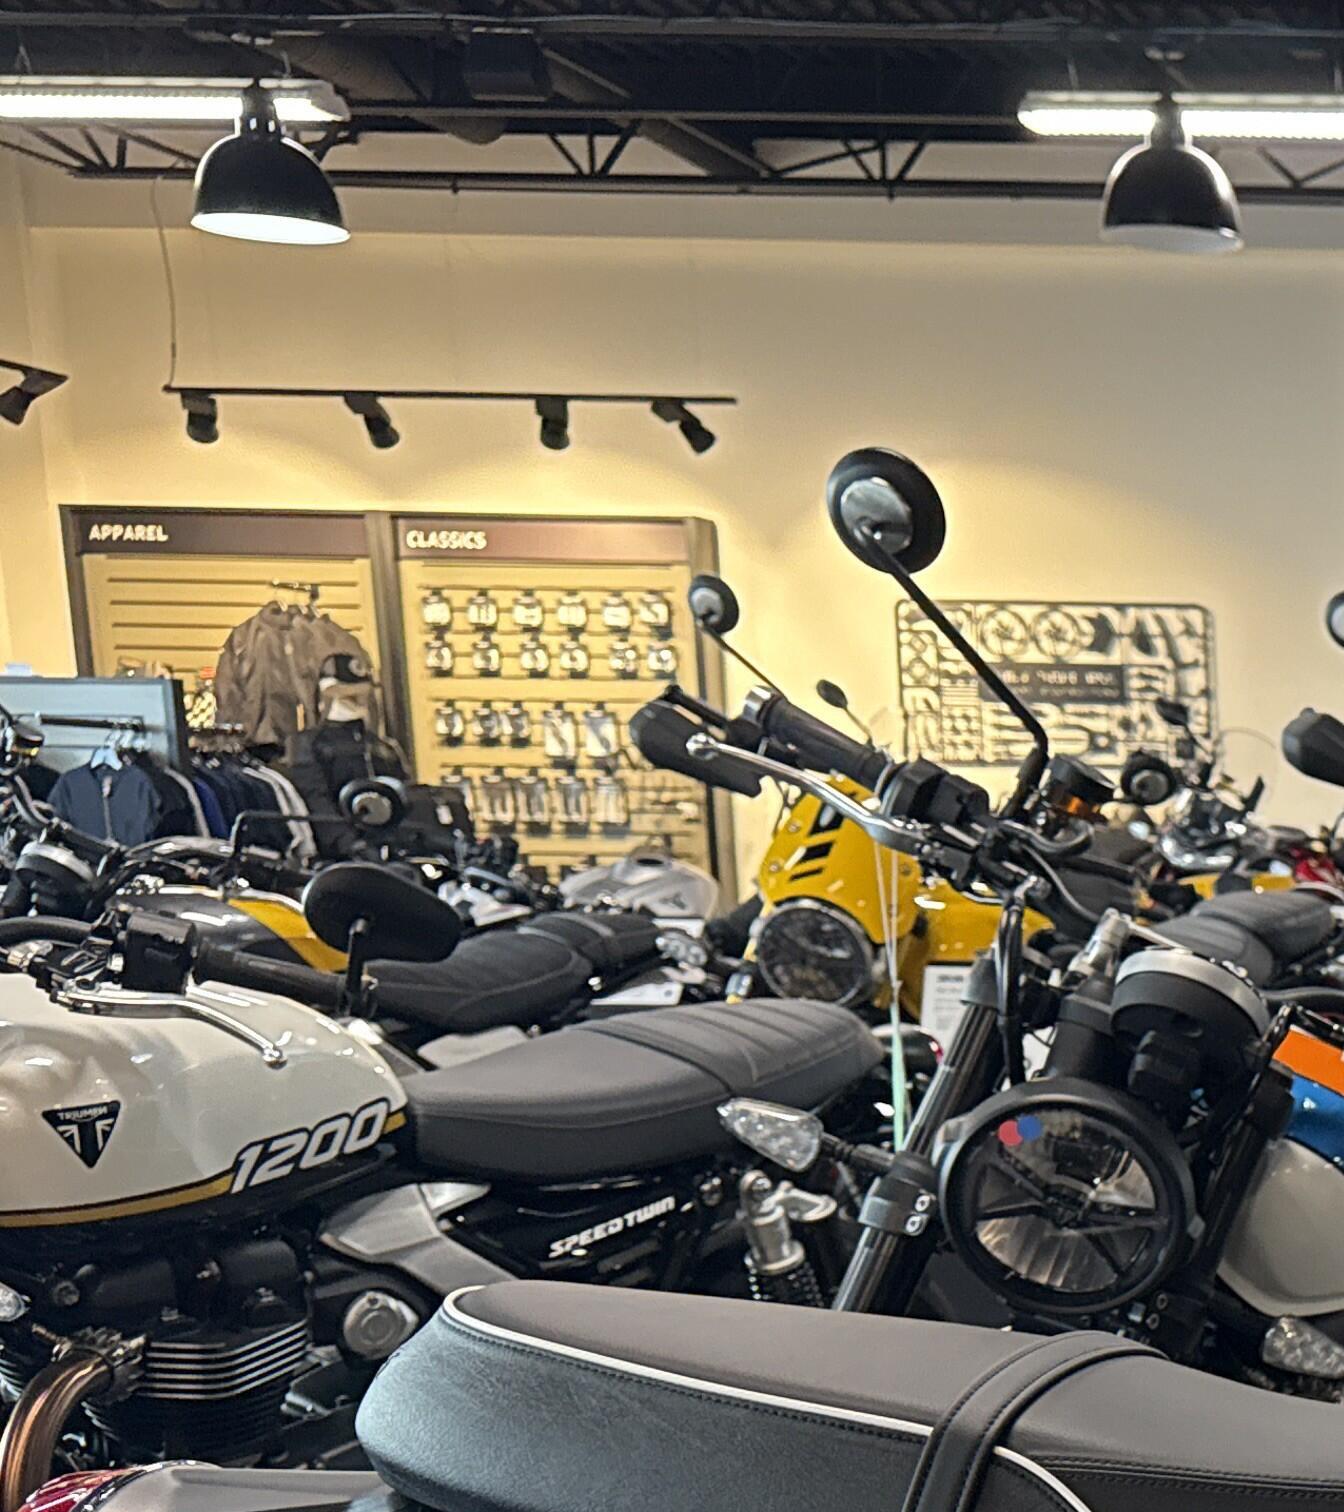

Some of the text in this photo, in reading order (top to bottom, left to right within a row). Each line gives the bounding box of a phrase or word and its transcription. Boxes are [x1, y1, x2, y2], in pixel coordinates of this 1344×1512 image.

[88, 523, 169, 543] APPAREL
[405, 529, 488, 551] CLASSICS
[230, 1098, 391, 1195] 1200
[548, 1196, 676, 1259] SPEED TWIN
